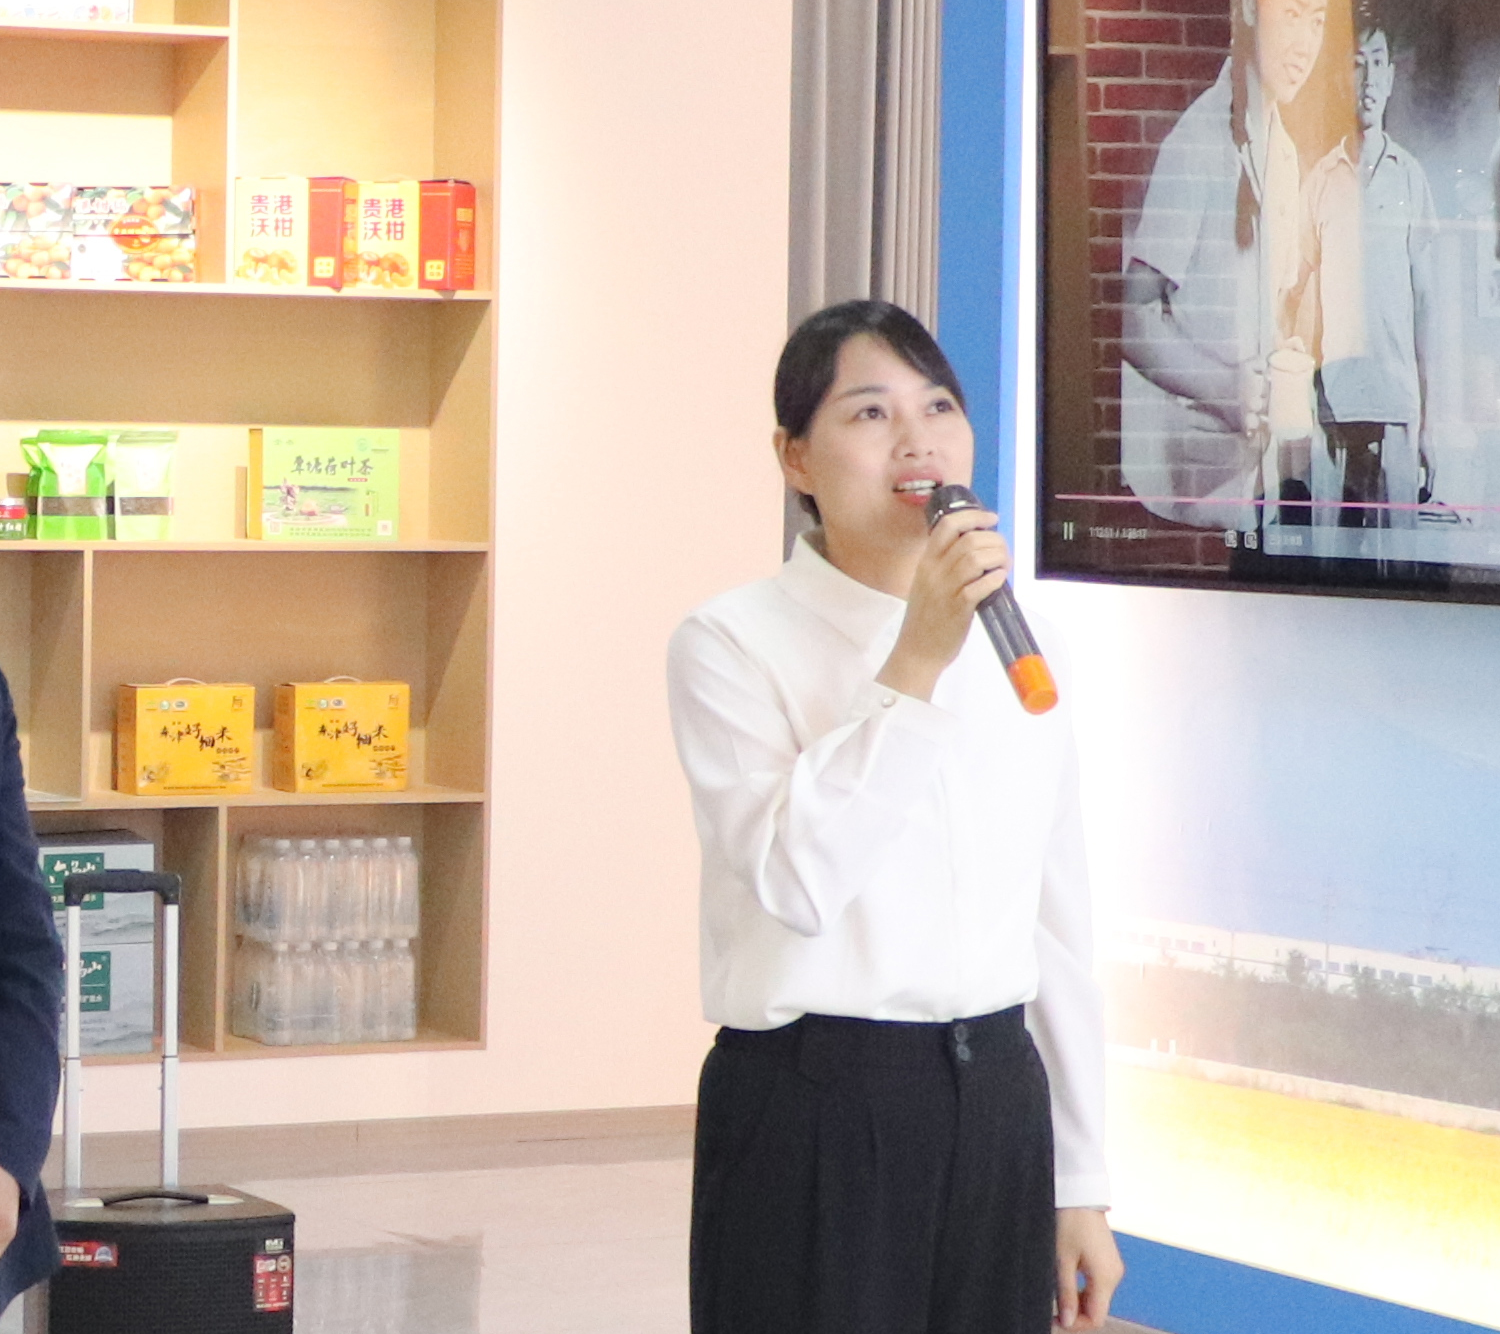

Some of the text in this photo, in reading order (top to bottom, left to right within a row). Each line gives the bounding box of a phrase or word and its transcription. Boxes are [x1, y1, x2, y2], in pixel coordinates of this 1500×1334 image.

[251, 194, 293, 215] 贵港
[363, 198, 405, 219] 贵港
[251, 217, 293, 237] 沃柑
[363, 221, 405, 241] 沃柑
